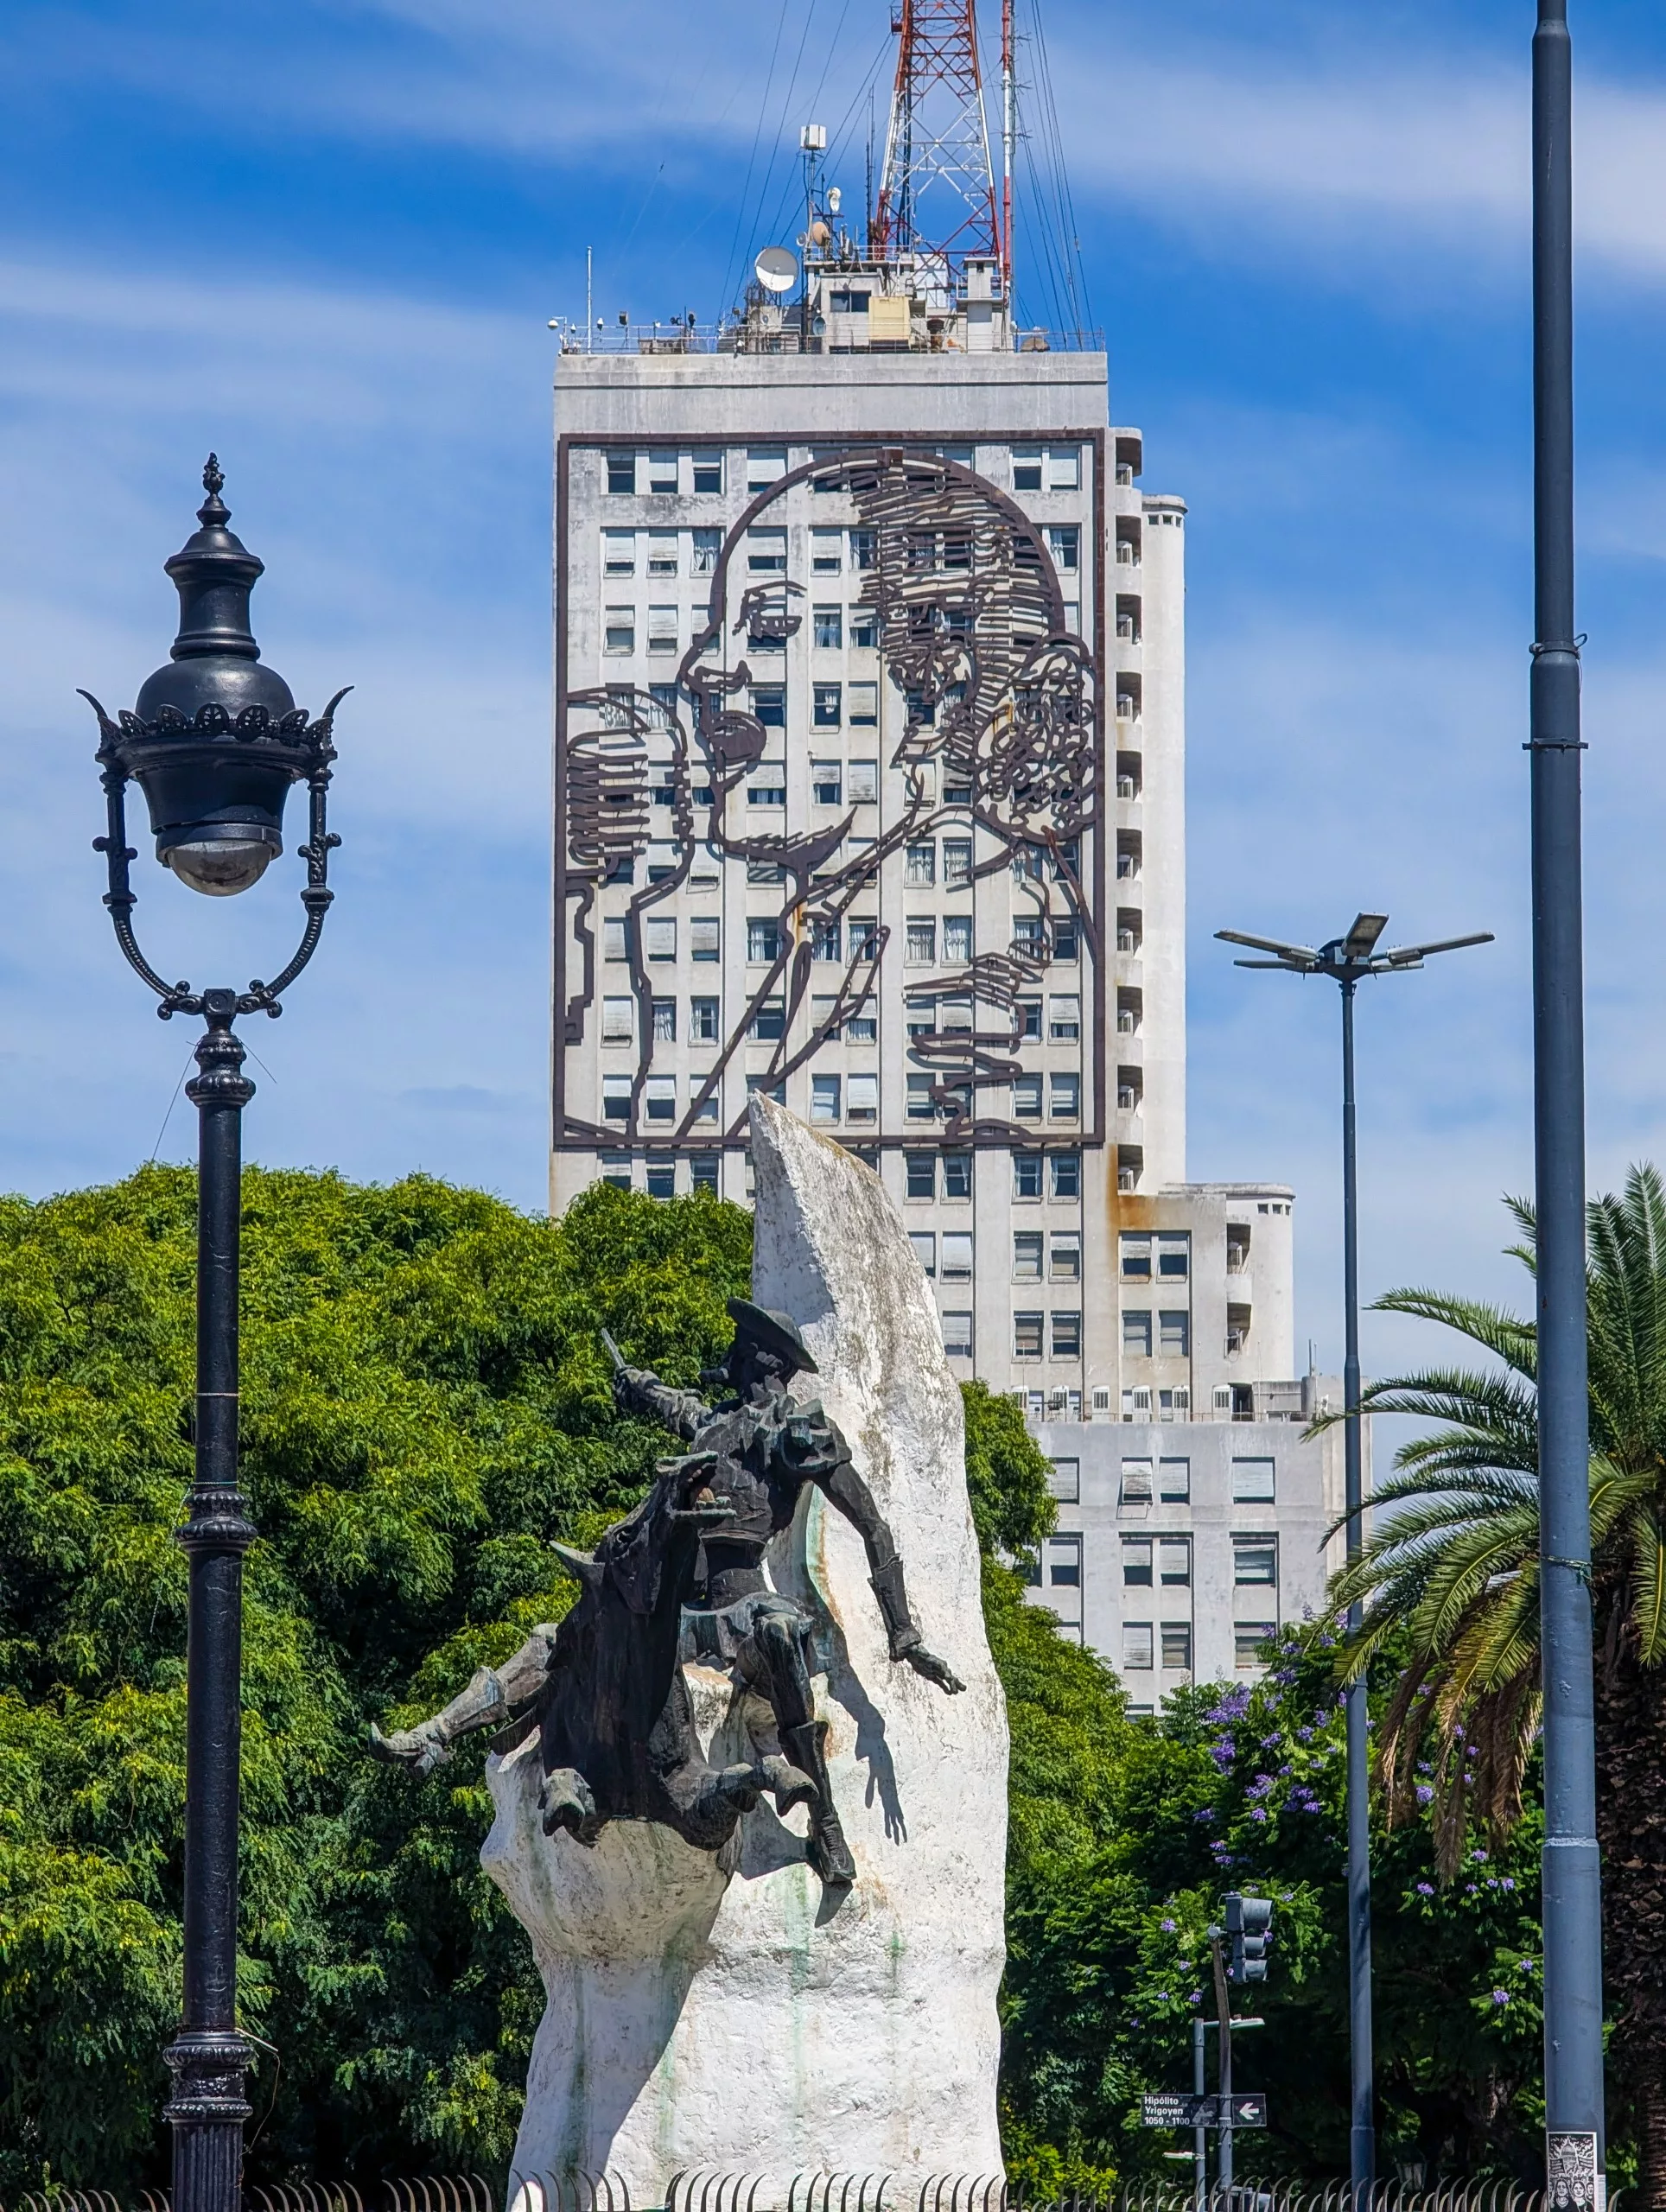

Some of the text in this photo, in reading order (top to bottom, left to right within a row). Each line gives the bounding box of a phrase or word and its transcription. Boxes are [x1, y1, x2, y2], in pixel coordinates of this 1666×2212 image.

[1144, 2095, 1179, 2106] Hipólito
[1145, 2106, 1184, 2117] Yrigoyen
[1144, 2116, 1164, 2125] 1050
[1172, 2117, 1190, 2126] 1100
